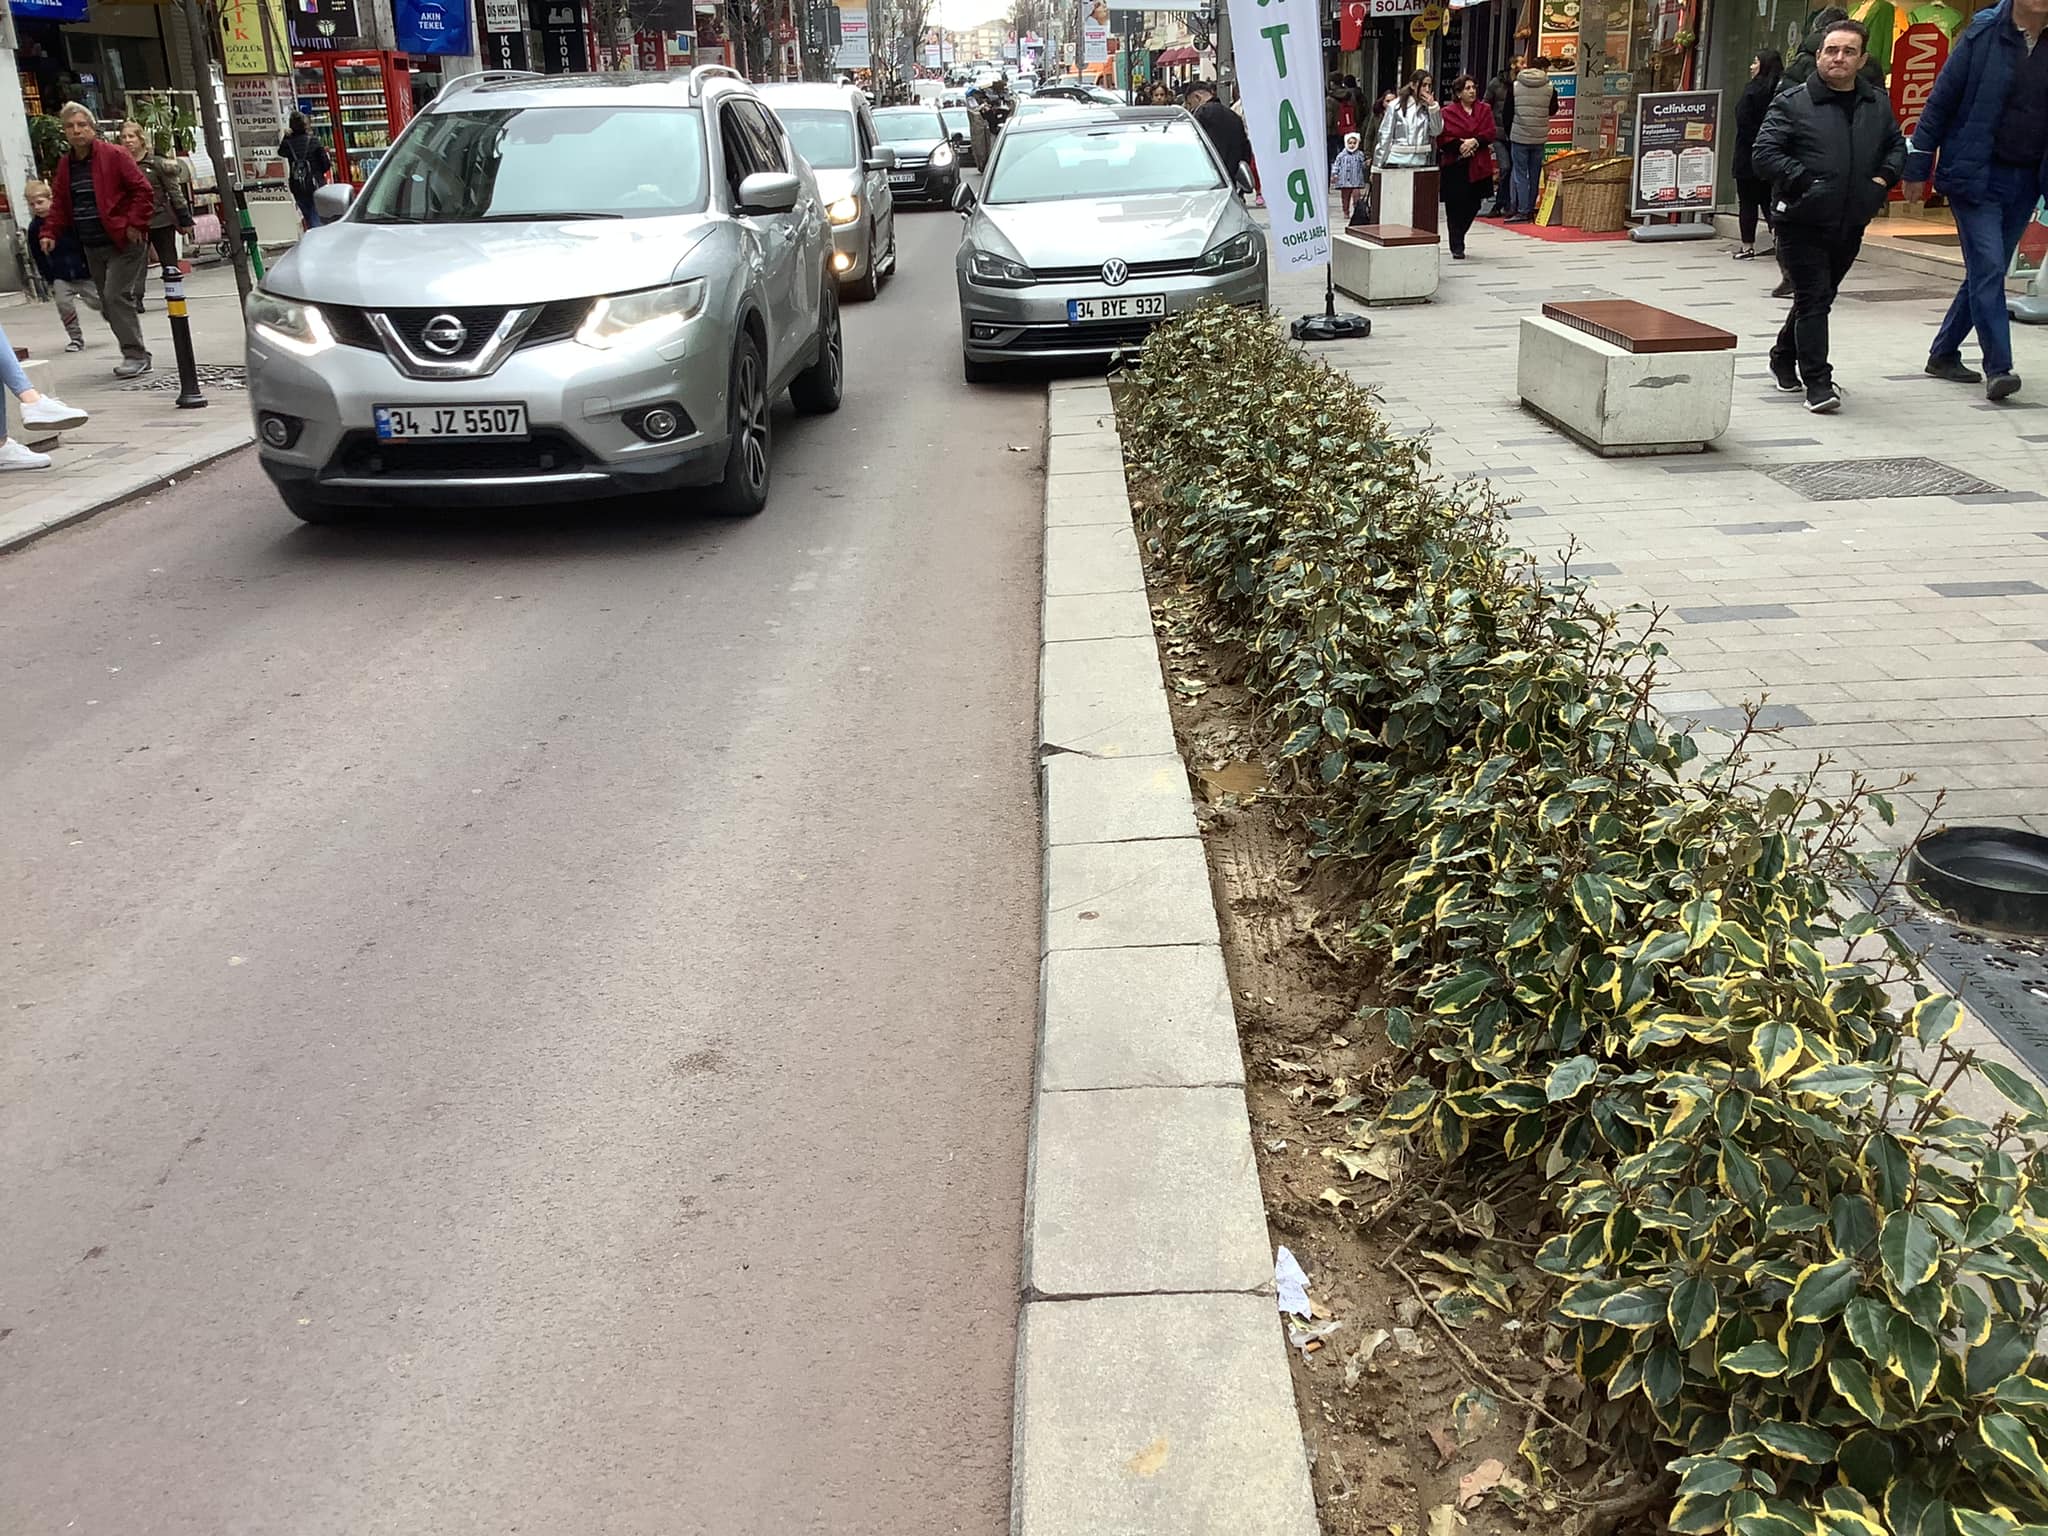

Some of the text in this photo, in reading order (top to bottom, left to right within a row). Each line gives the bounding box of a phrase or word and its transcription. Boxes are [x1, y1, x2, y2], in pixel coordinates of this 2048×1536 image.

[421, 12, 441, 20] AKIN
[418, 21, 445, 30] TEKEL
[1653, 103, 1707, 117] Çetinkaya
[236, 117, 251, 125] TÜL
[1078, 298, 1162, 318] 34 BYE 932
[391, 408, 520, 435] 34 JZ 5507
